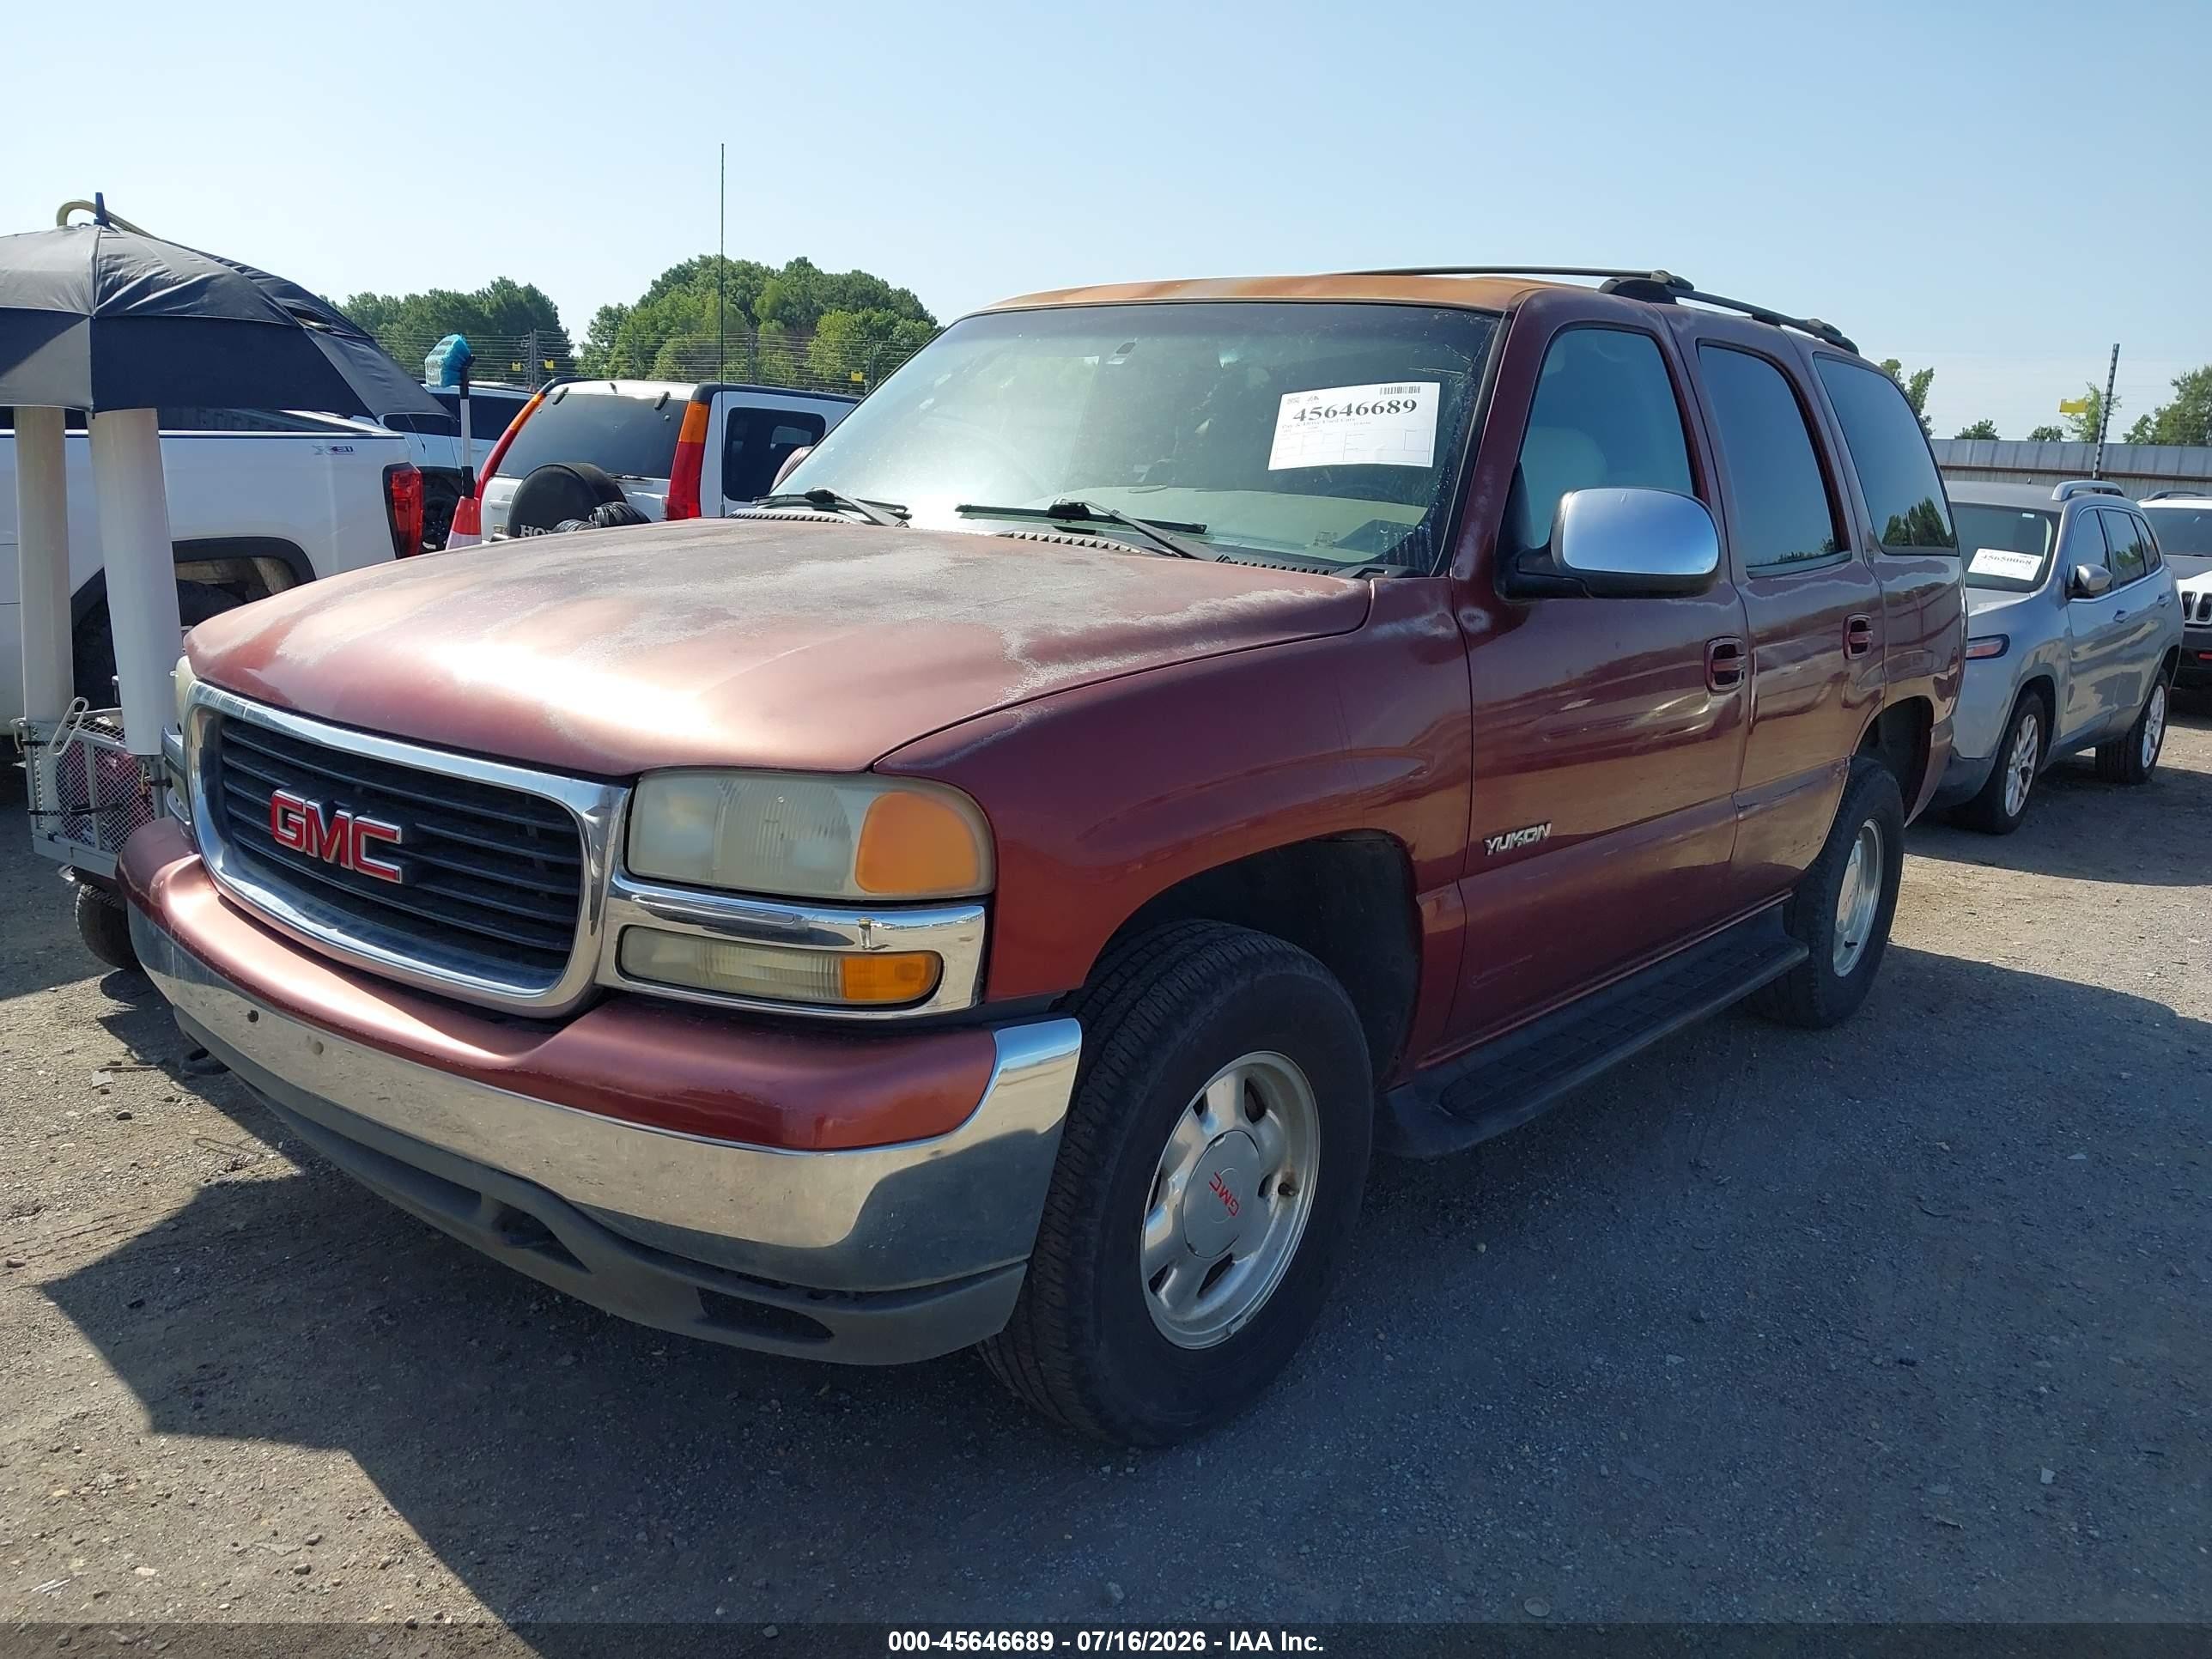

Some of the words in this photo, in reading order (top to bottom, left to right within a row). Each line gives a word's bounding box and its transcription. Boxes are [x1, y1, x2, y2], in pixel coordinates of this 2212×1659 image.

[1292, 398, 1418, 422] 45646689
[270, 789, 403, 884] GMC
[1485, 823, 1553, 856] YUKON
[1208, 1170, 1240, 1217] GMC
